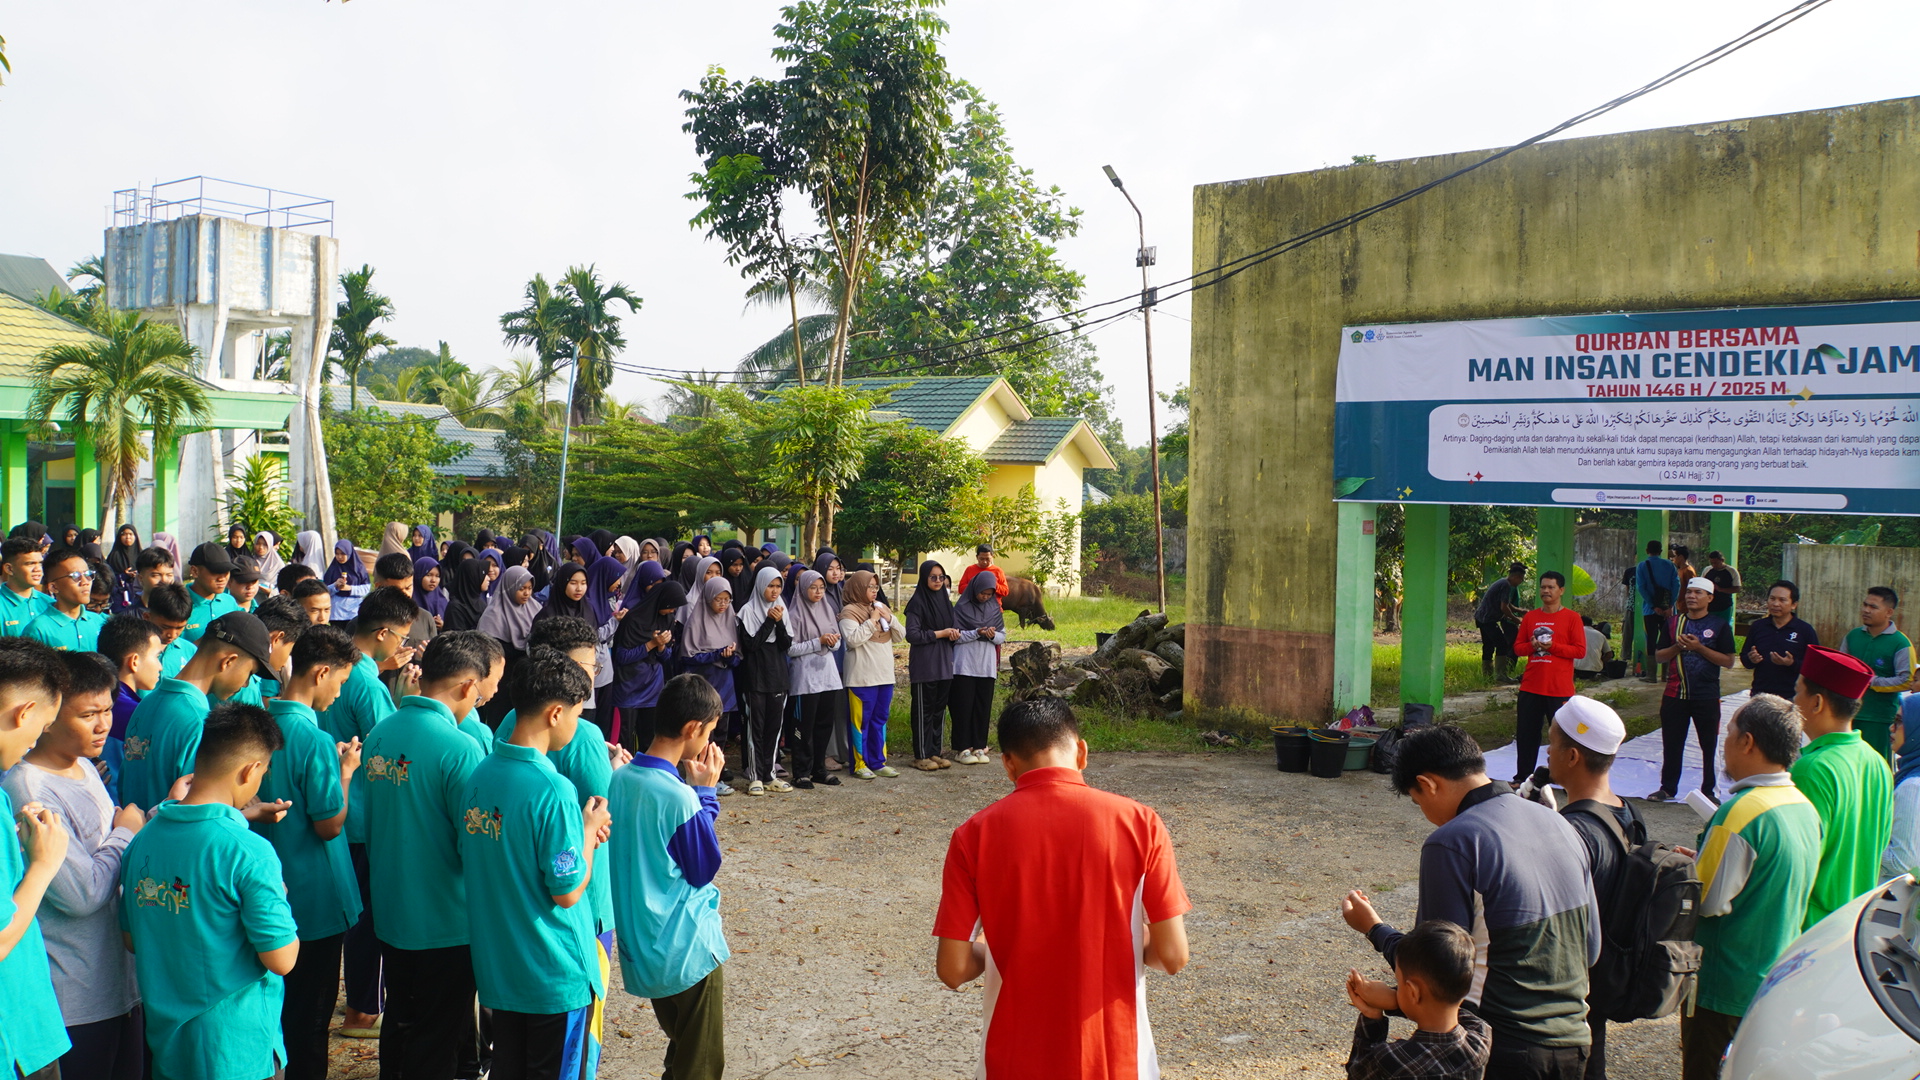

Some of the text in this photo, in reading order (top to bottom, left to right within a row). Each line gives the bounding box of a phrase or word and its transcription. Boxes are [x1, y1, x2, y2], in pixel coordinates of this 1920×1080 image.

[1575, 326, 1800, 353] QURBAN BERSAMA
[1468, 356, 1534, 382] MAN
[1545, 354, 1640, 380] INSAN
[1652, 348, 1826, 378] CENDEKIA
[1587, 381, 1786, 398] TAHUN 1446 H / 2025 M
[1443, 434, 1467, 444] Artinya:
[1470, 434, 1514, 444] Daging-daging
[1531, 434, 1544, 442] dan
[1544, 434, 1574, 444] darahnya
[1576, 434, 1585, 442] itu
[1586, 434, 1618, 442] sekali-kali
[1620, 434, 1636, 442] tidak
[1638, 435, 1658, 444] dapat
[1660, 435, 1694, 444] mencapai
[1695, 435, 1736, 444] (keridhaan)
[1737, 435, 1758, 444] Allah,
[1760, 435, 1780, 444] tetapi
[1782, 435, 1822, 443] ketakwaan
[1824, 435, 1840, 444] dari
[1841, 435, 1875, 444] kamulah
[1876, 436, 1896, 445] yang
[1899, 436, 1920, 444] dapa
[1484, 446, 1920, 458] Demikianlah Allah telah menundukkannya untuk kamu supaya kamu mengagungkan Allah terhadap hidayah-Nya kepada kam
[1578, 458, 1808, 470] Dan berilah kabar gembira kepada orang-orang yang berbuat baik.
[1664, 471, 1678, 480] Q.S
[1688, 472, 1704, 481] Hajj:
[1706, 472, 1715, 480] 37
